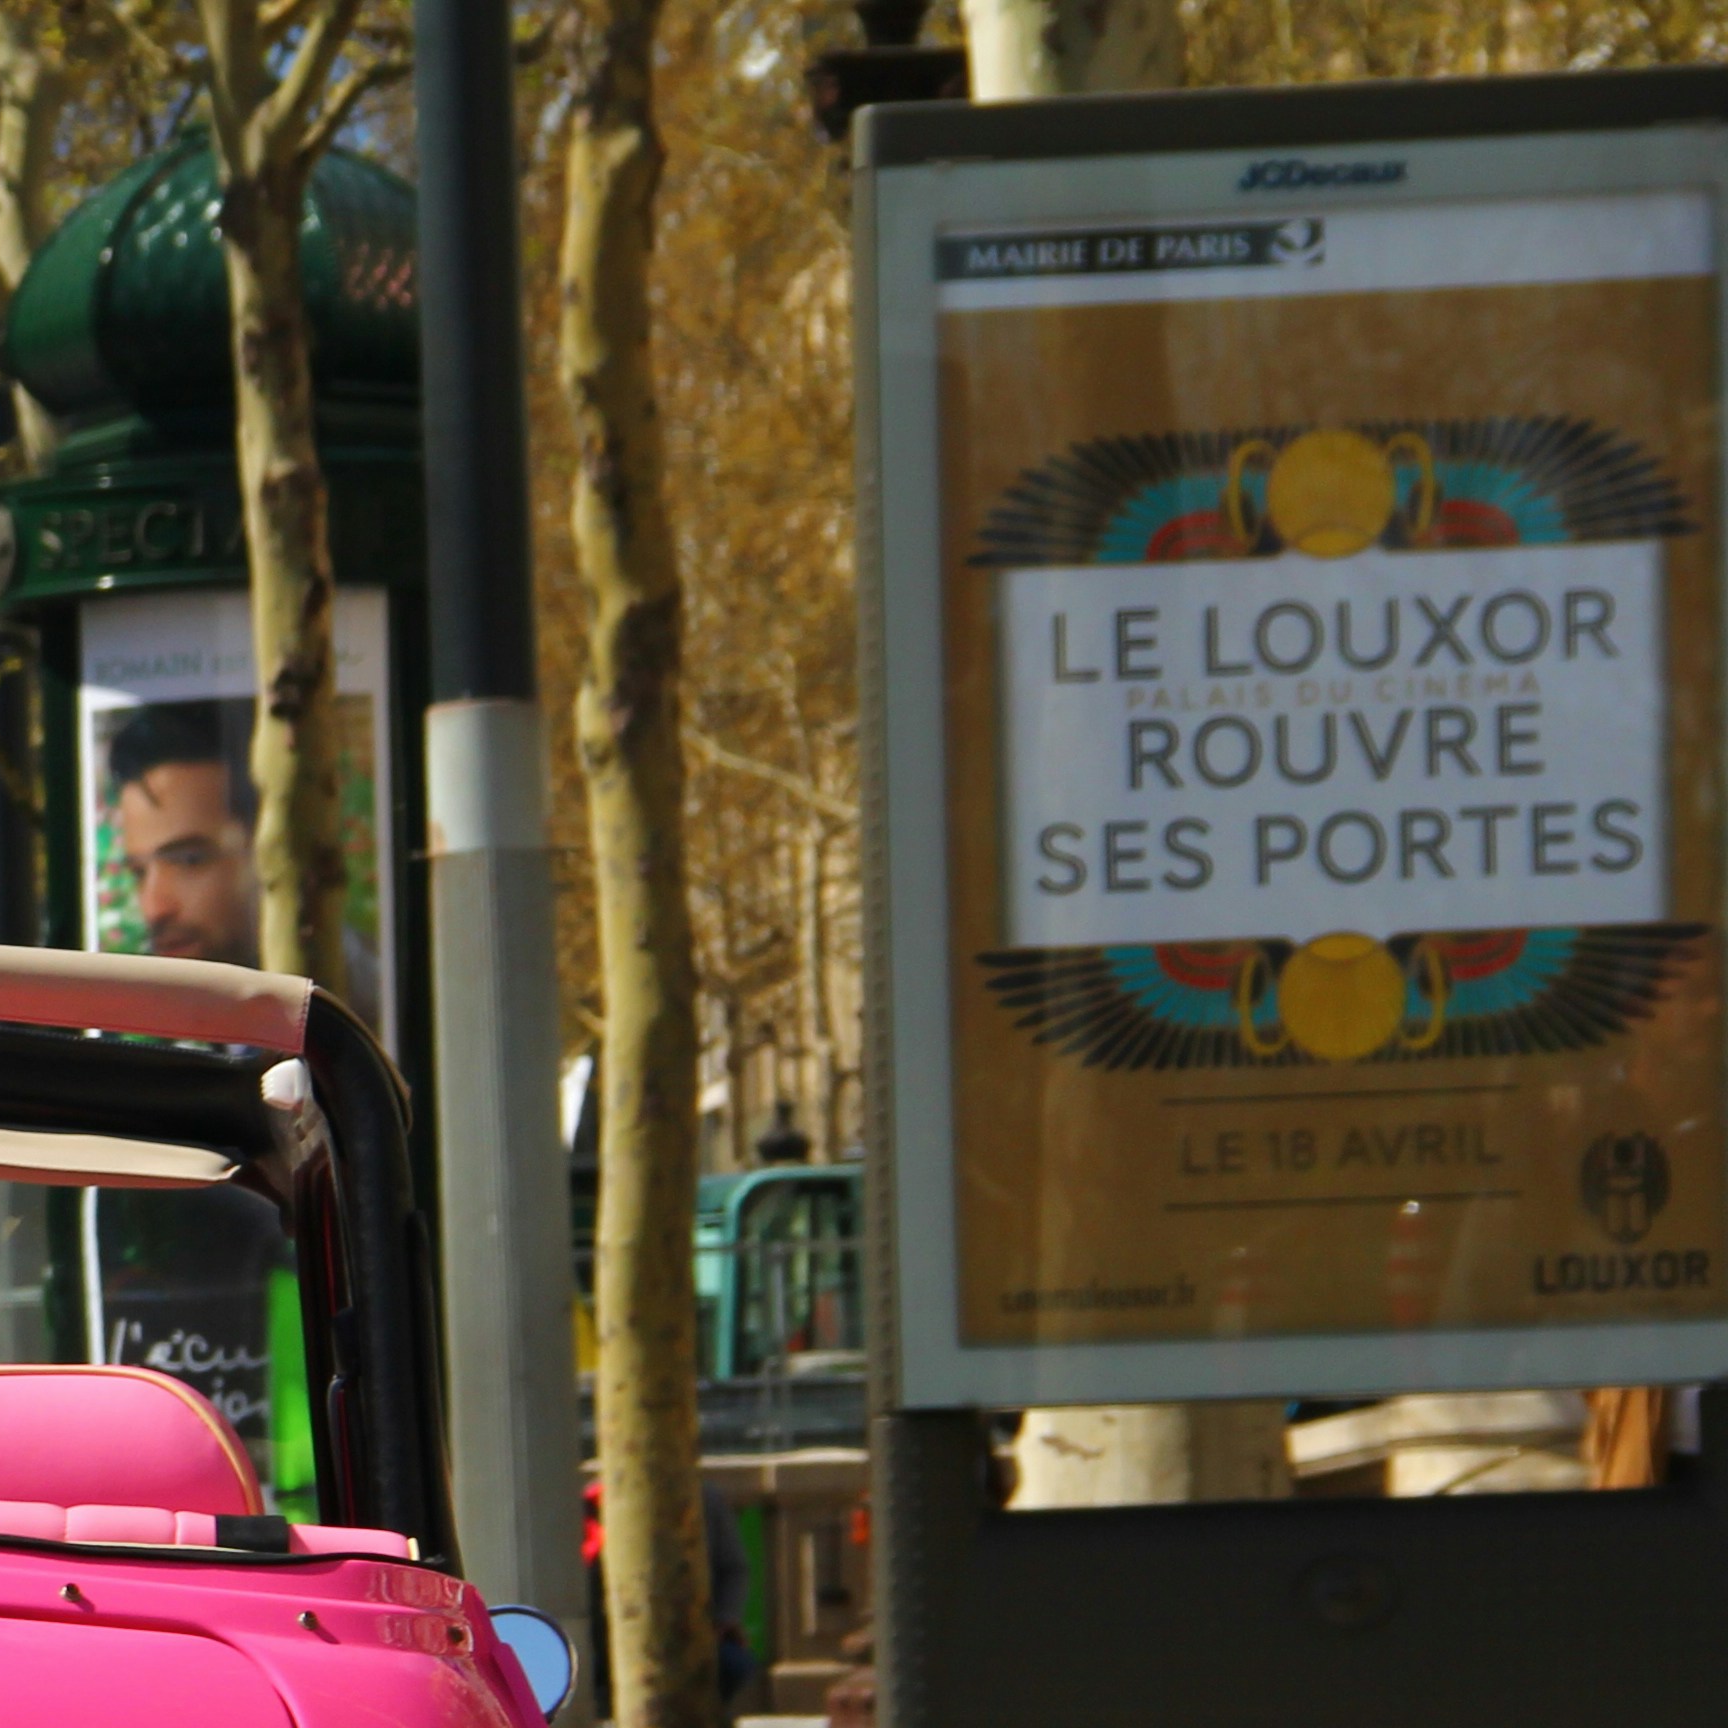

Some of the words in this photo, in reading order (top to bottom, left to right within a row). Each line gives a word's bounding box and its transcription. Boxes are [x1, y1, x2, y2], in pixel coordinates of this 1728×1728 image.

[1240, 159, 1406, 191] JCDecaux
[968, 242, 1088, 273] MAIRIE
[1100, 238, 1144, 266] DE
[1157, 232, 1250, 262] PARIS
[1052, 608, 1161, 684] LE
[1205, 588, 1621, 676] LOUXOR
[1126, 682, 1273, 710] PALAIS
[1296, 677, 1354, 706] DU
[1128, 704, 1545, 790] ROUVRE
[1037, 817, 1215, 896] SES
[1255, 800, 1644, 886] PORTES
[1180, 1131, 1243, 1175] LE
[1267, 1130, 1317, 1172] 18
[1336, 1121, 1502, 1169] AVRIL
[1533, 1249, 1711, 1296] LOUXOR
